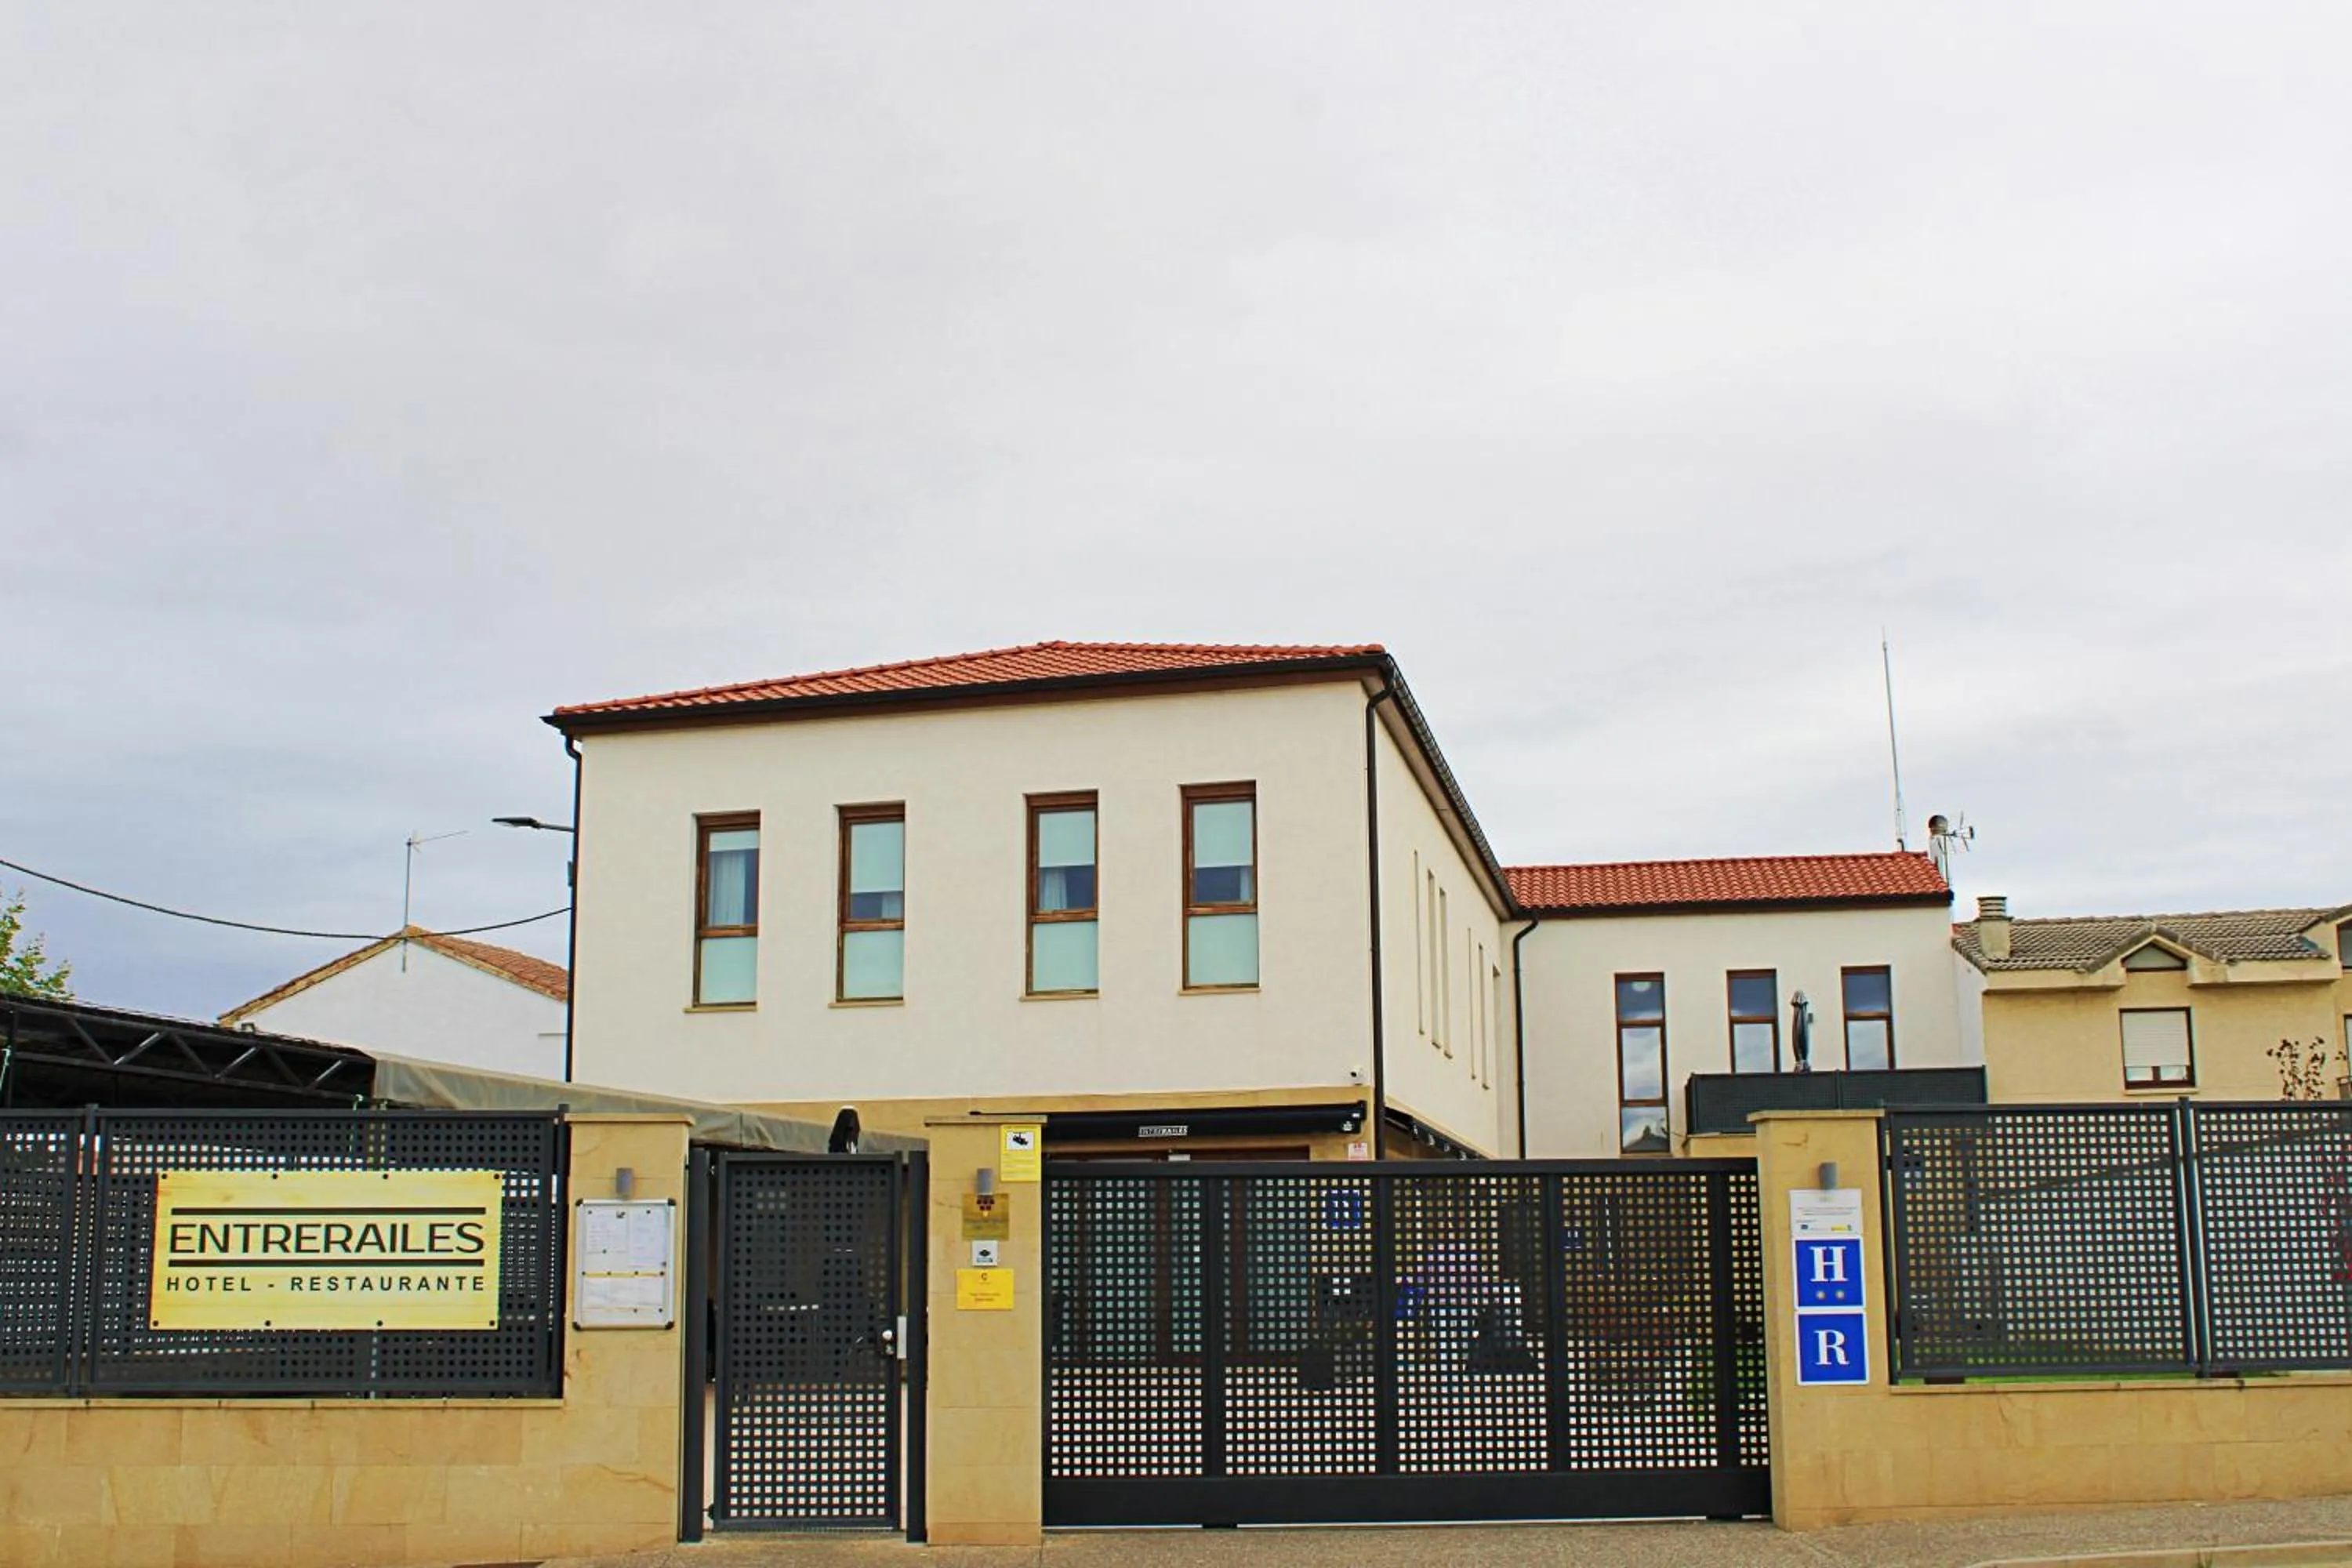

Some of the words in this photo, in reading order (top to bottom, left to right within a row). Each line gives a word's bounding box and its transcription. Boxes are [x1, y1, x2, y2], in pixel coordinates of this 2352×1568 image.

[169, 1222, 485, 1254] ENTRERAILES
[1809, 1246, 1849, 1283] H
[166, 1276, 252, 1292] HOTEL
[290, 1276, 485, 1292] RESTAURANTE
[1813, 1329, 1850, 1366] R
